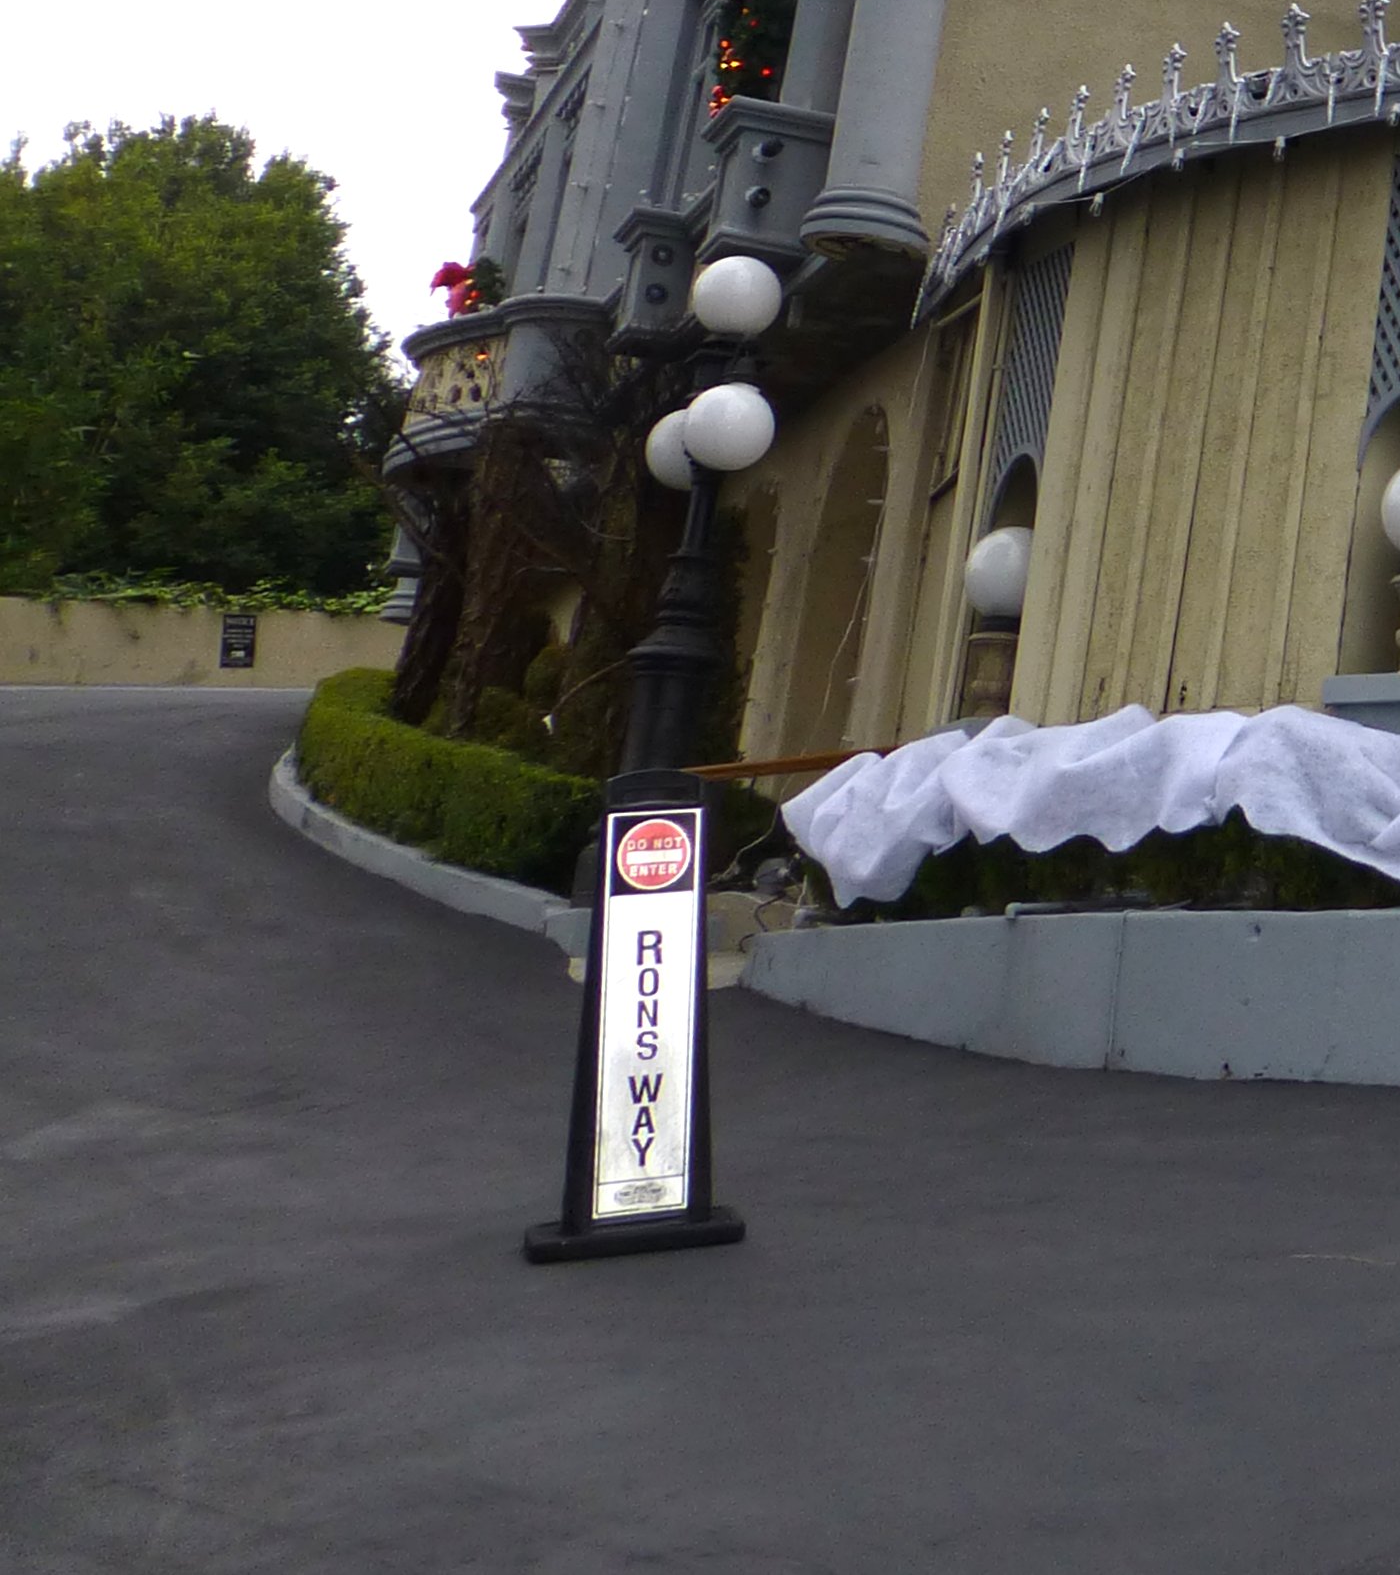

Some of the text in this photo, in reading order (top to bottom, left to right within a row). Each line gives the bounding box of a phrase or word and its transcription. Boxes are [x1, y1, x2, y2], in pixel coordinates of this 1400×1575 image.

[626, 836, 683, 850] DO NOT
[629, 863, 678, 877] ENTER
[635, 930, 662, 1061] RONS
[628, 1072, 663, 1167] WAY
